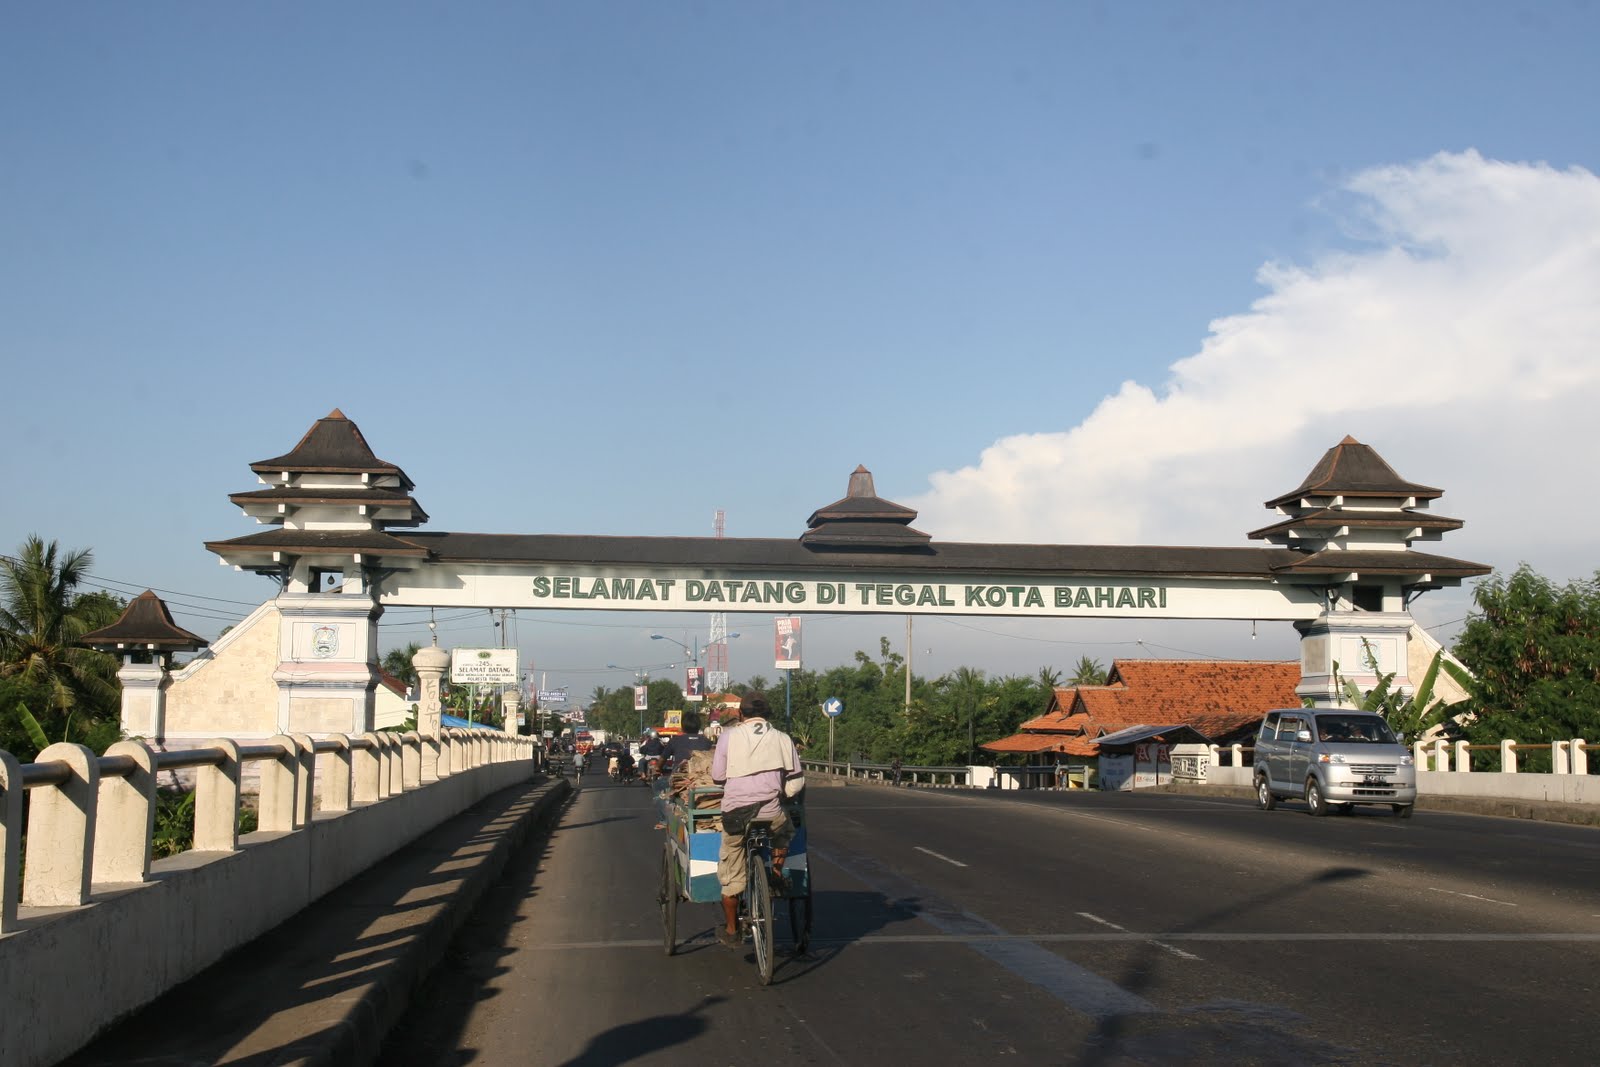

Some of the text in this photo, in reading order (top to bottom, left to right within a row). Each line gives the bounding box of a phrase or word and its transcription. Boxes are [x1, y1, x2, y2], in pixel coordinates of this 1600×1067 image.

[532, 576, 1167, 608] SELAMAT DATANG DI TEGAL KOTA BAHARI
